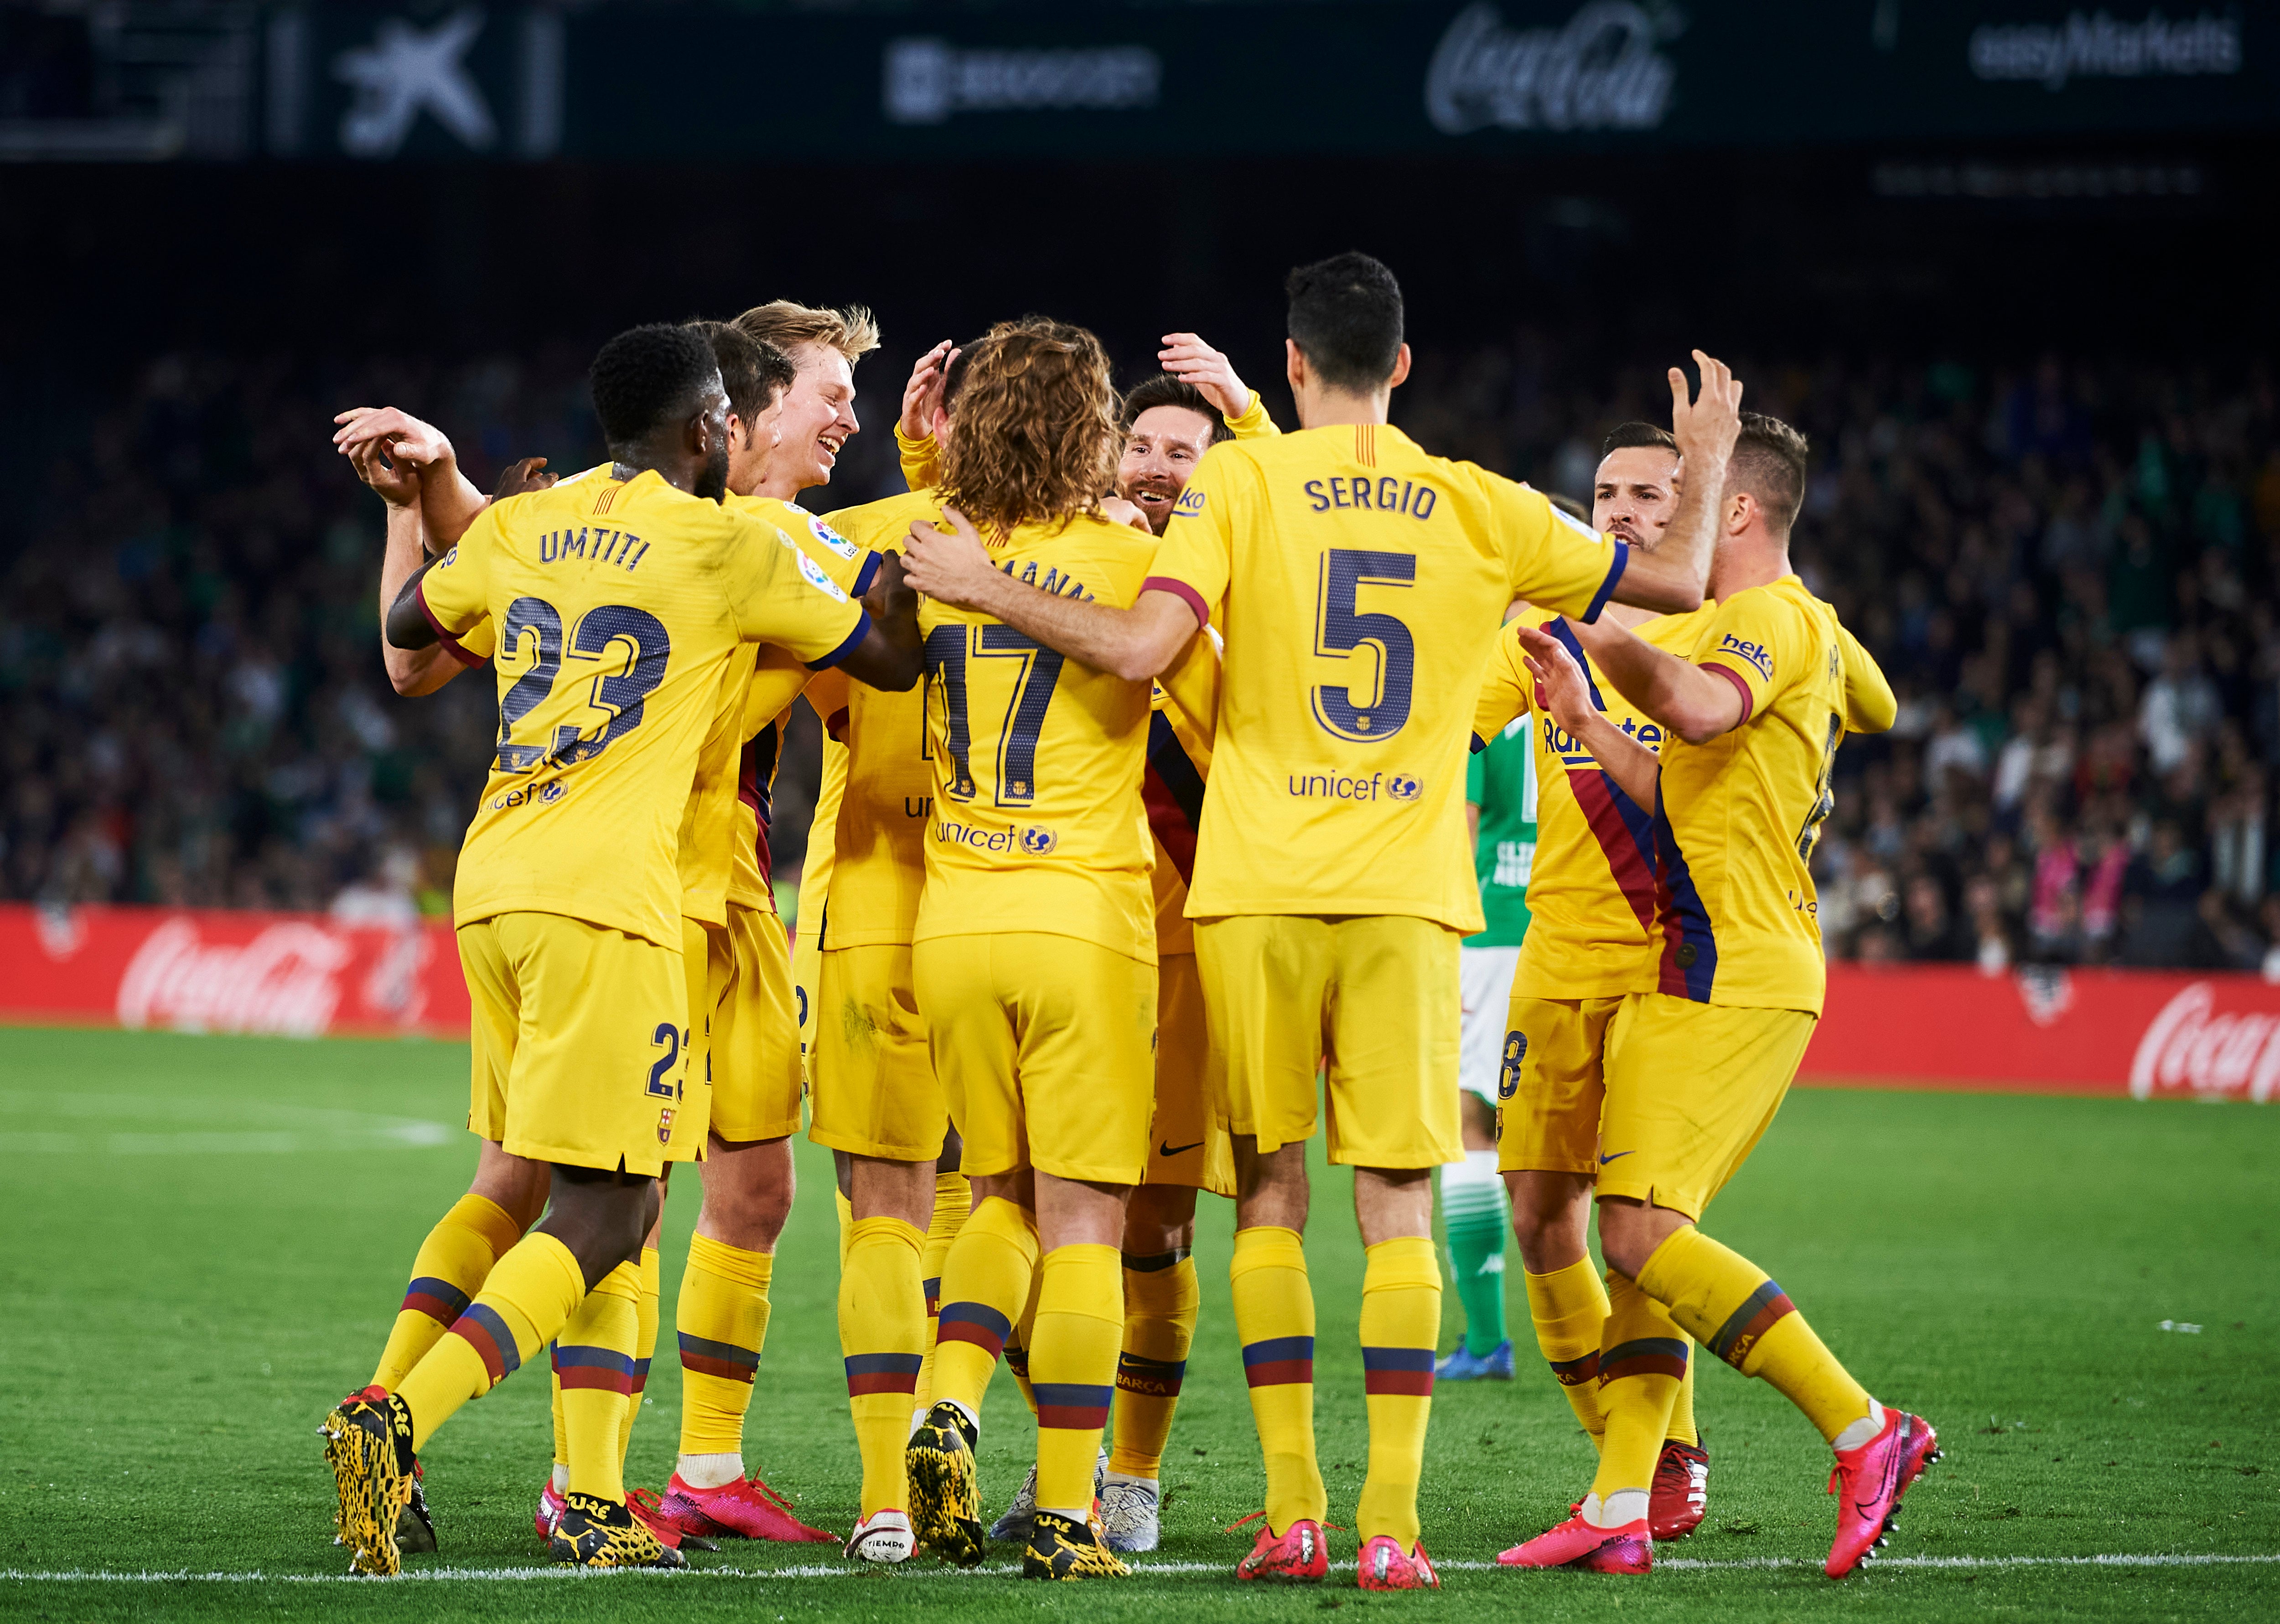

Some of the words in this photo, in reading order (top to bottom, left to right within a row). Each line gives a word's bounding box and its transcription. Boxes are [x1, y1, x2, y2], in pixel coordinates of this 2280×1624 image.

[1304, 477, 1436, 521] SERGIO
[539, 527, 651, 572] UMTITI
[1311, 549, 1415, 743] 5
[496, 597, 670, 774] 23
[923, 623, 1065, 808] 17
[1289, 769, 1382, 801] unicef
[936, 822, 1016, 852] unicef
[1117, 1372, 1166, 1393] BARÇA
[868, 1541, 904, 1549] TIEMPO
